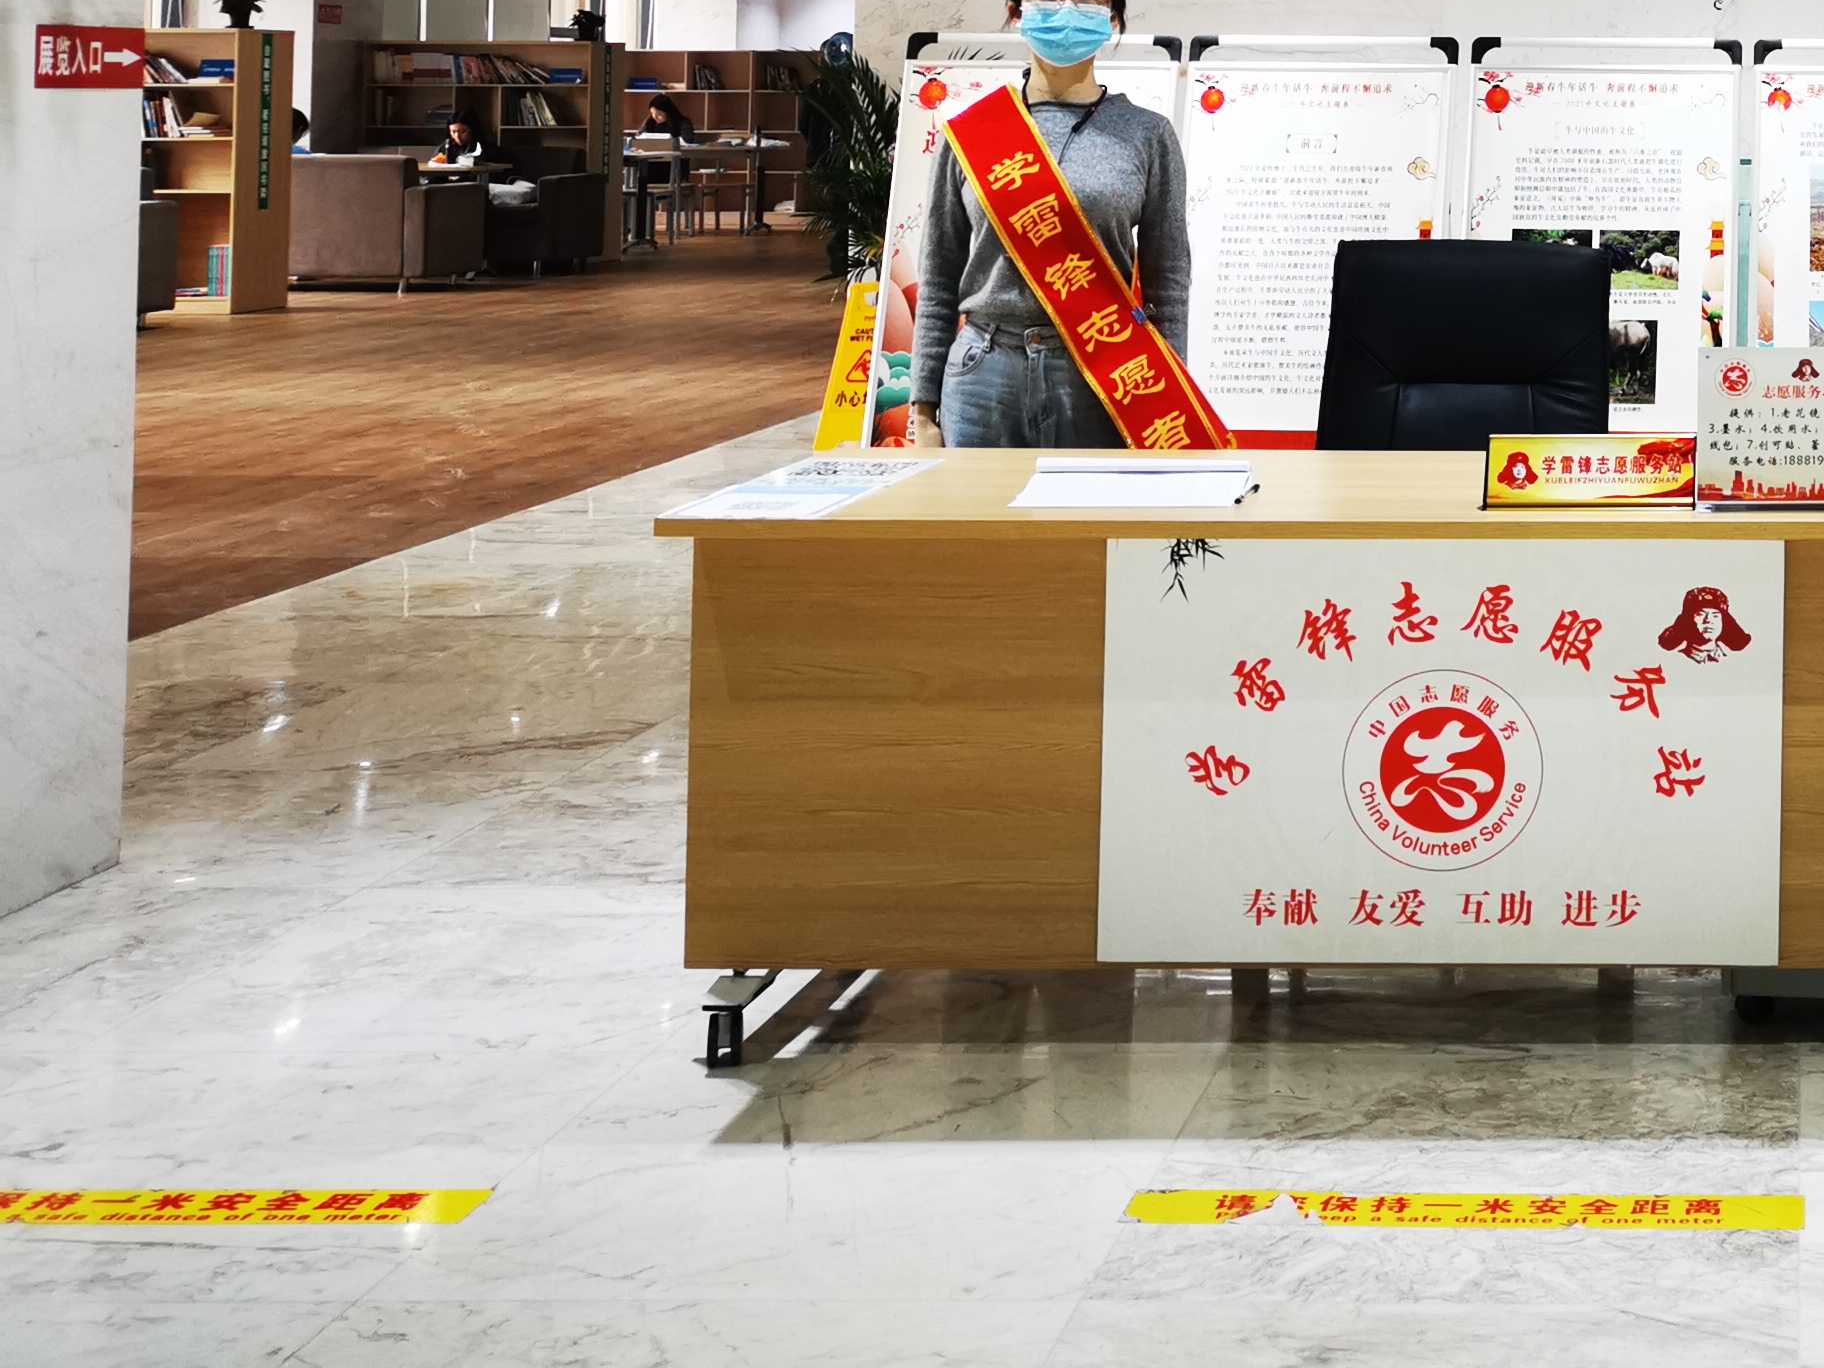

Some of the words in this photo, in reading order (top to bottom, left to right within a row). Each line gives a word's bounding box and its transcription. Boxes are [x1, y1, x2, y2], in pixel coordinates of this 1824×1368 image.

[38, 35, 102, 75] 展览入口
[987, 152, 1190, 449] 学雷锋志愿者
[835, 390, 868, 407] 小心
[1542, 454, 1682, 474] 学雷锋志愿服务站
[1187, 581, 1707, 799] 学雷锋志愿服务站
[1366, 683, 1522, 743] 中国志愿服务
[1358, 779, 1391, 831] China
[1391, 824, 1480, 858] Volunteer
[1478, 780, 1527, 843] Service
[1242, 888, 1319, 927] 奉献
[1348, 888, 1426, 927] 友爱
[1456, 888, 1533, 927] 互助
[1560, 888, 1642, 927] 进步
[100, 1213, 211, 1221] distance
[224, 1213, 254, 1222] of
[323, 1214, 402, 1222] meter
[1396, 1215, 1442, 1223] safe
[1455, 1215, 1553, 1224] distance
[1567, 1216, 1588, 1225] of
